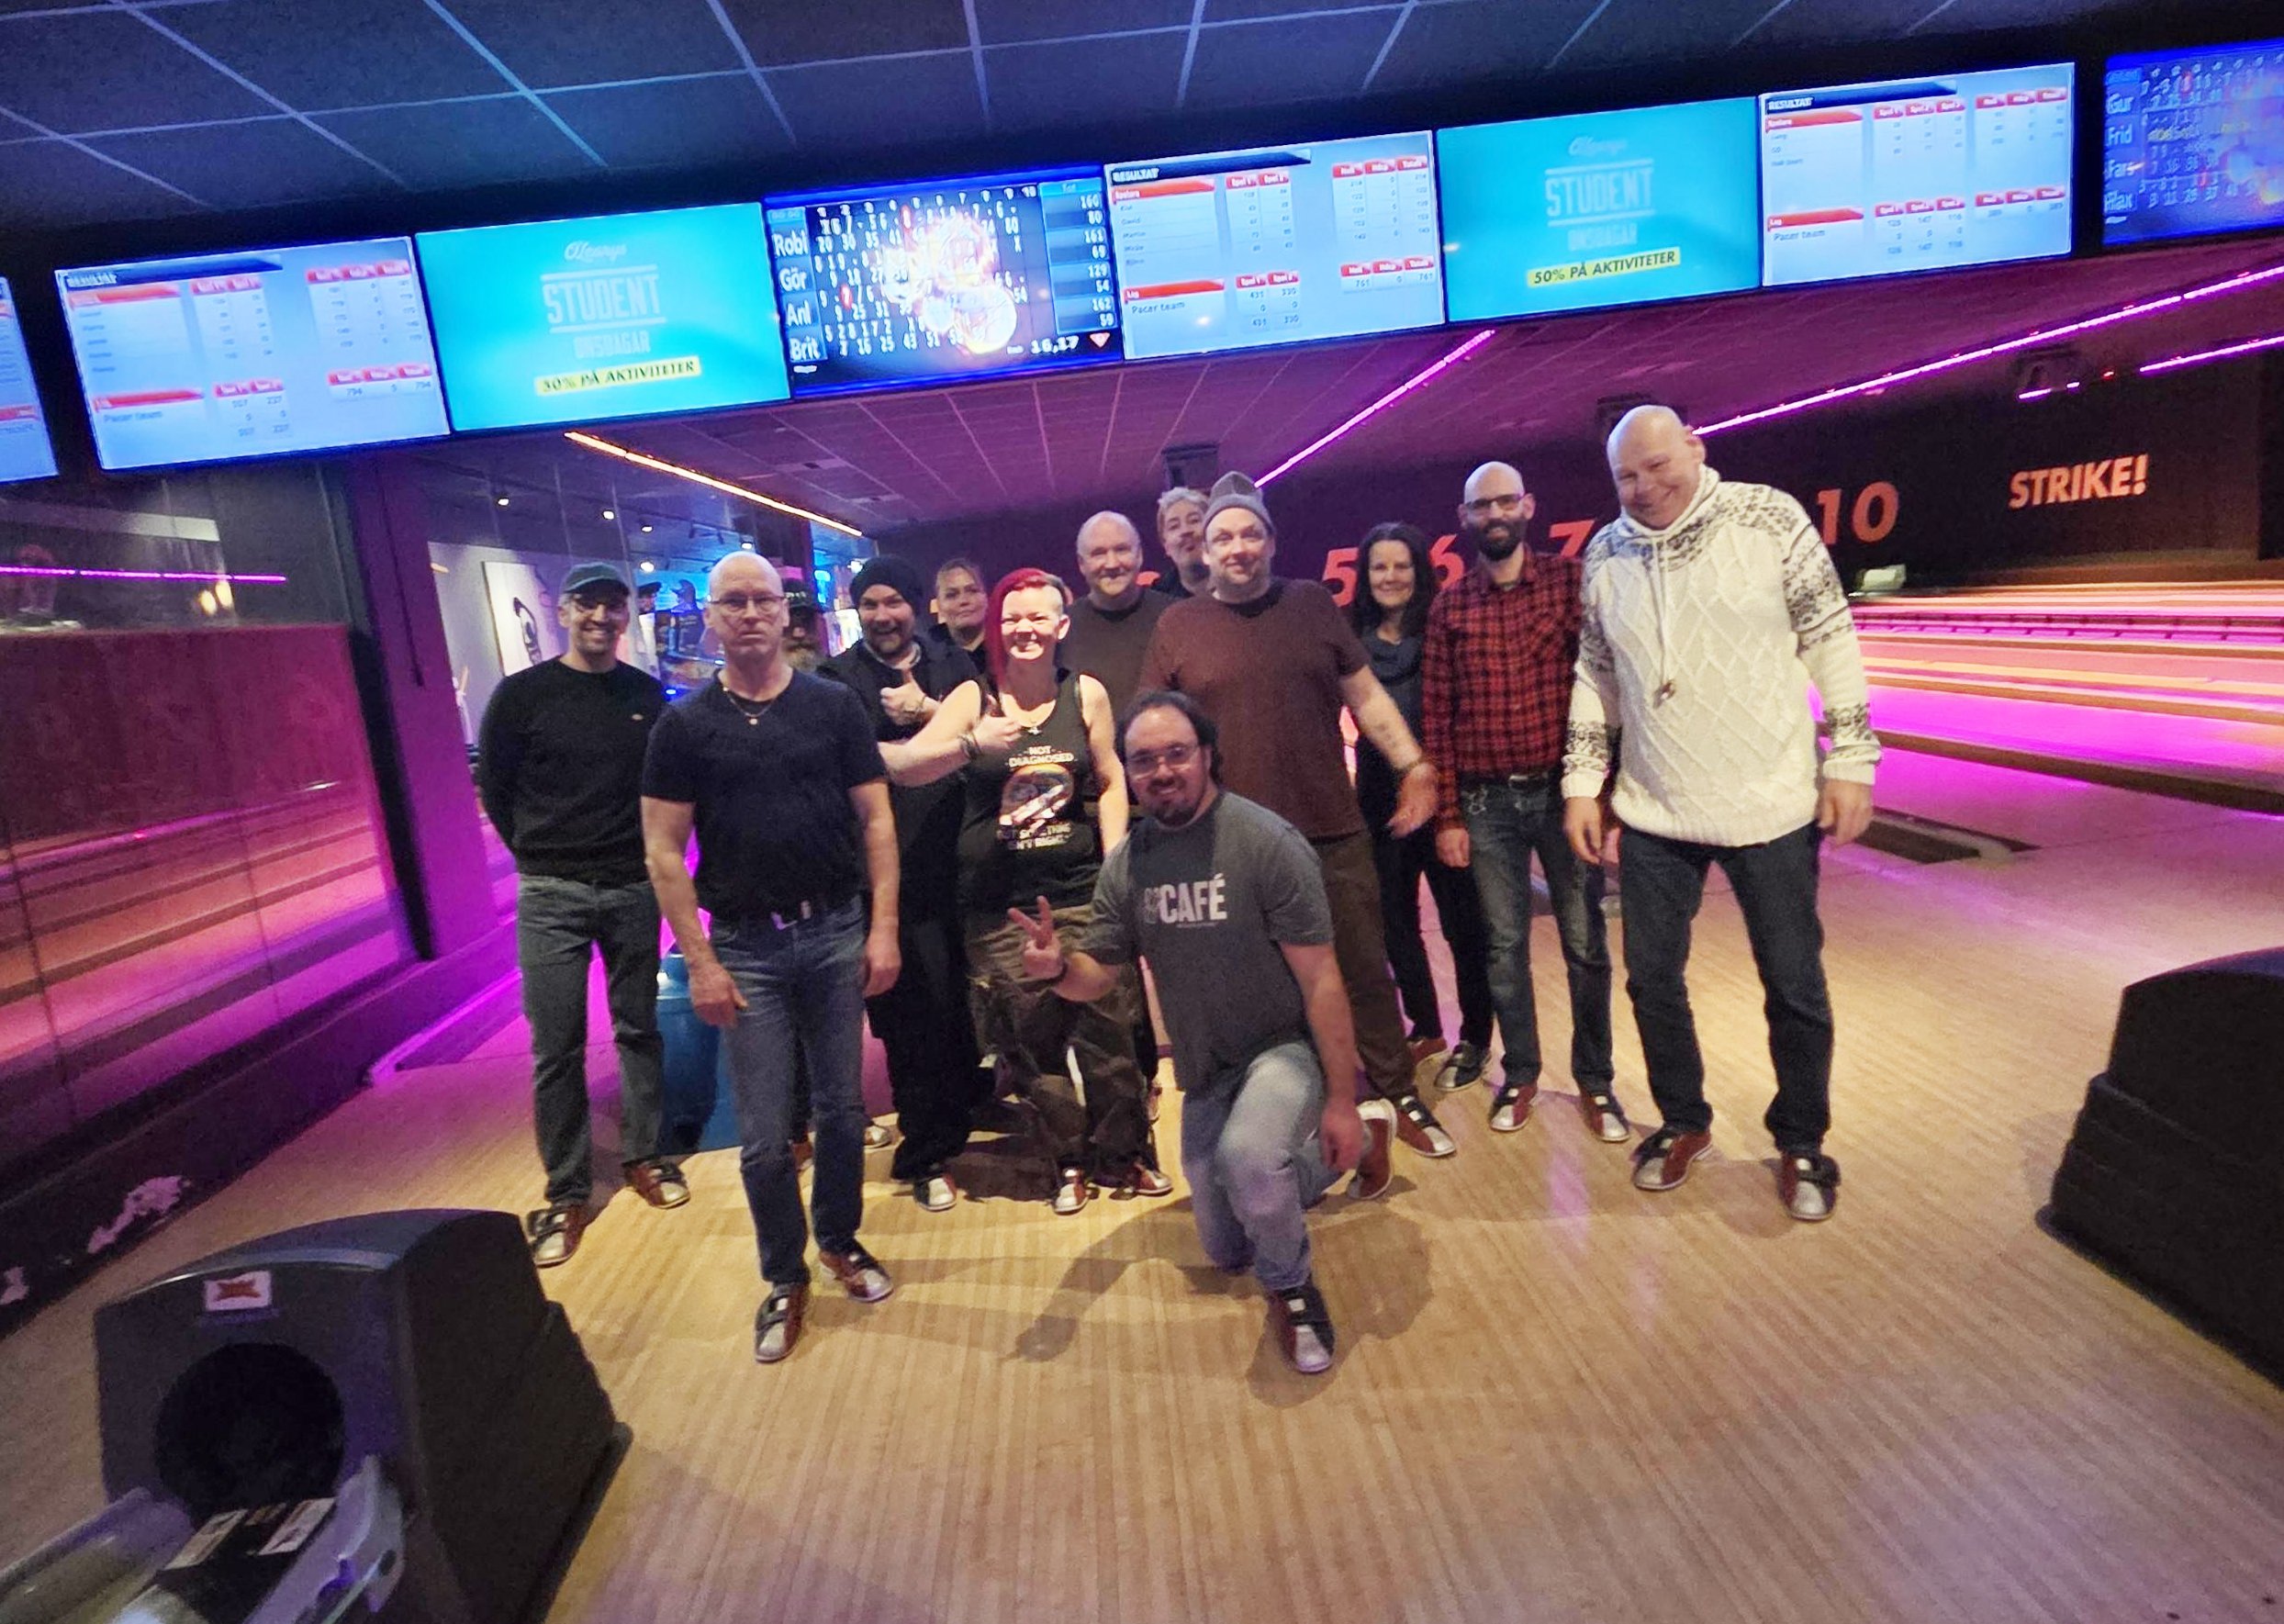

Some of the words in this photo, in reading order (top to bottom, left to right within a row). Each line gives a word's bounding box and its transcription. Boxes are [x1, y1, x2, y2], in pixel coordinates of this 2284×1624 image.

[1080, 194, 1100, 209] 160
[1545, 169, 1652, 218] STUDENT
[1533, 267, 1566, 285] 50%
[1570, 263, 1588, 279] PÅ
[1592, 250, 1675, 275] AKTIVITETER
[542, 274, 663, 324] STUDENT
[1160, 301, 1185, 312] team
[605, 360, 696, 384] AKTIVITETER
[789, 335, 822, 361] Brit
[2008, 453, 2149, 510] STRIKE!
[1817, 481, 1899, 545] 10
[1323, 547, 1359, 608] 5
[1430, 534, 1465, 590] 6
[1159, 872, 1228, 924] CAFÉ
